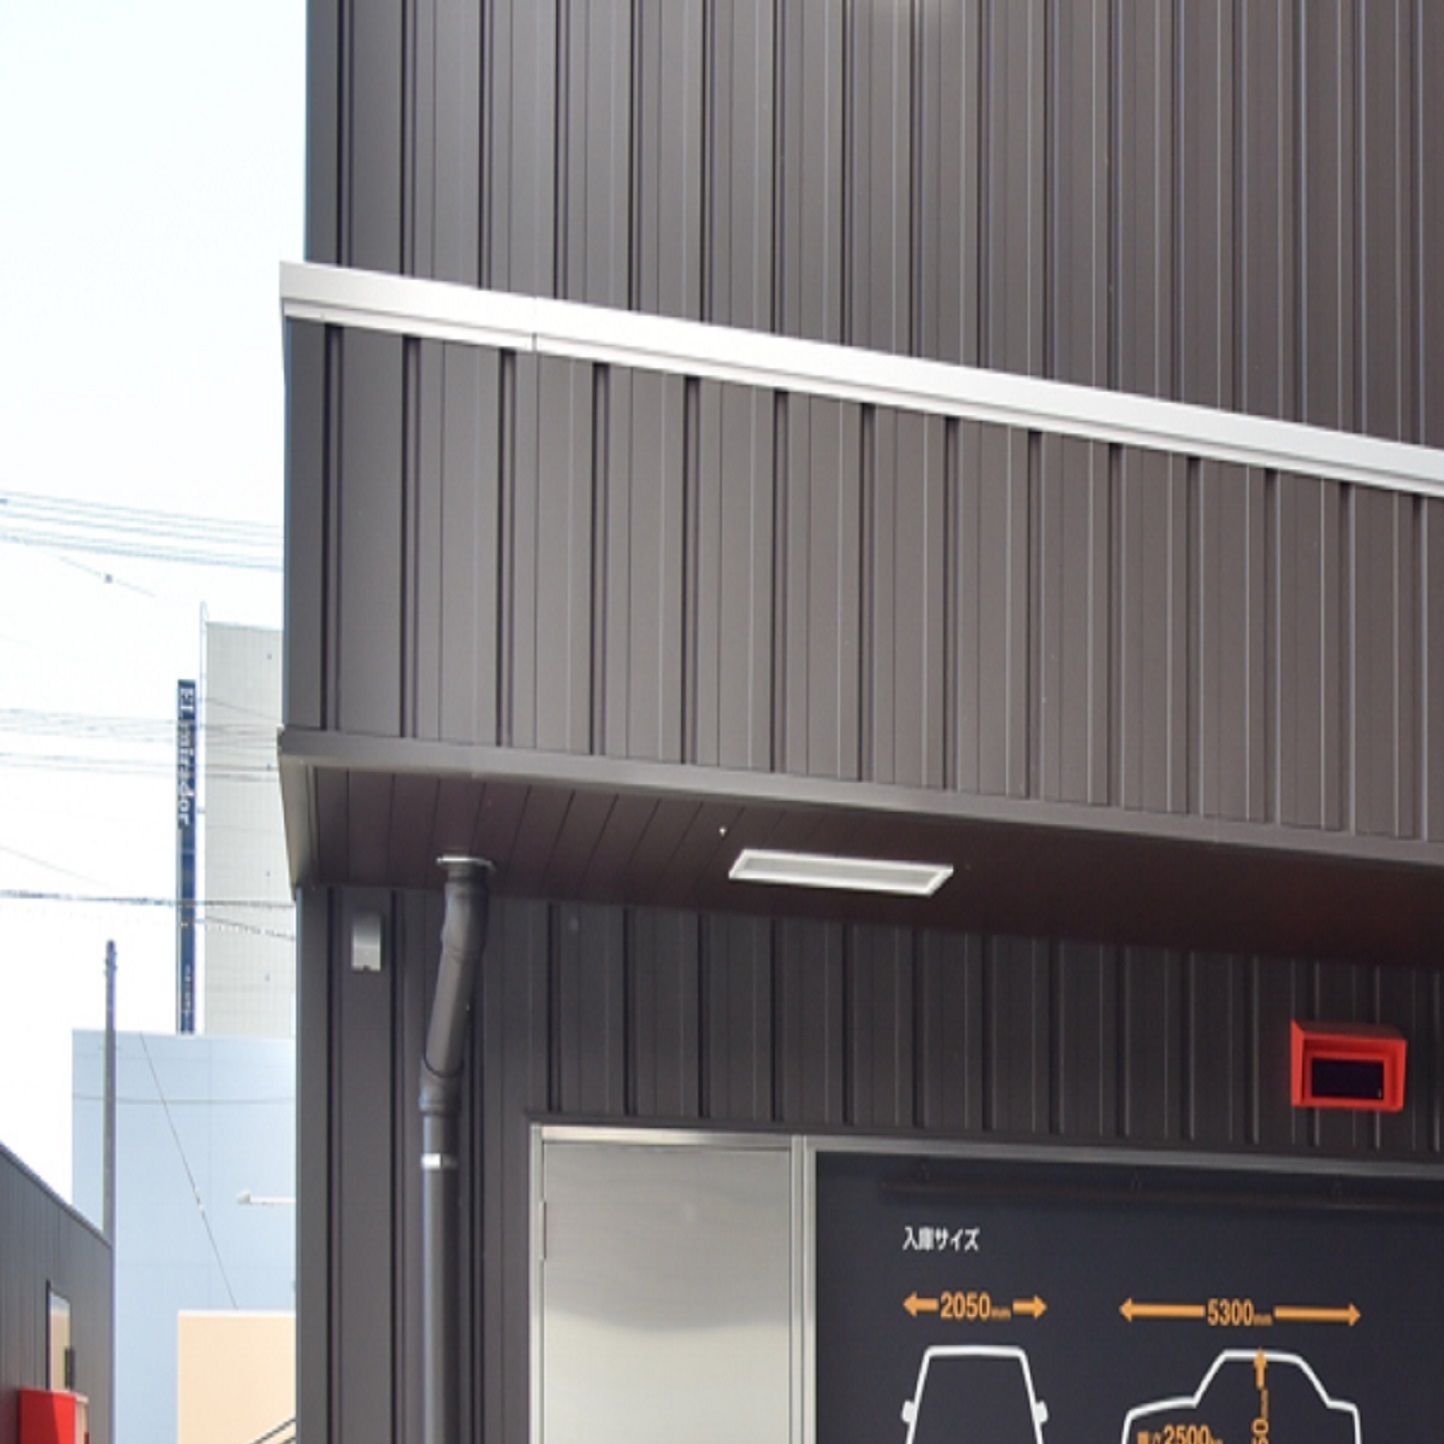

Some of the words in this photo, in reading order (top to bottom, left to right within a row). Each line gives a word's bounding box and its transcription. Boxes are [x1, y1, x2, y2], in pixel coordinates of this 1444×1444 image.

[902, 1225, 981, 1251] 入庫サイズ
